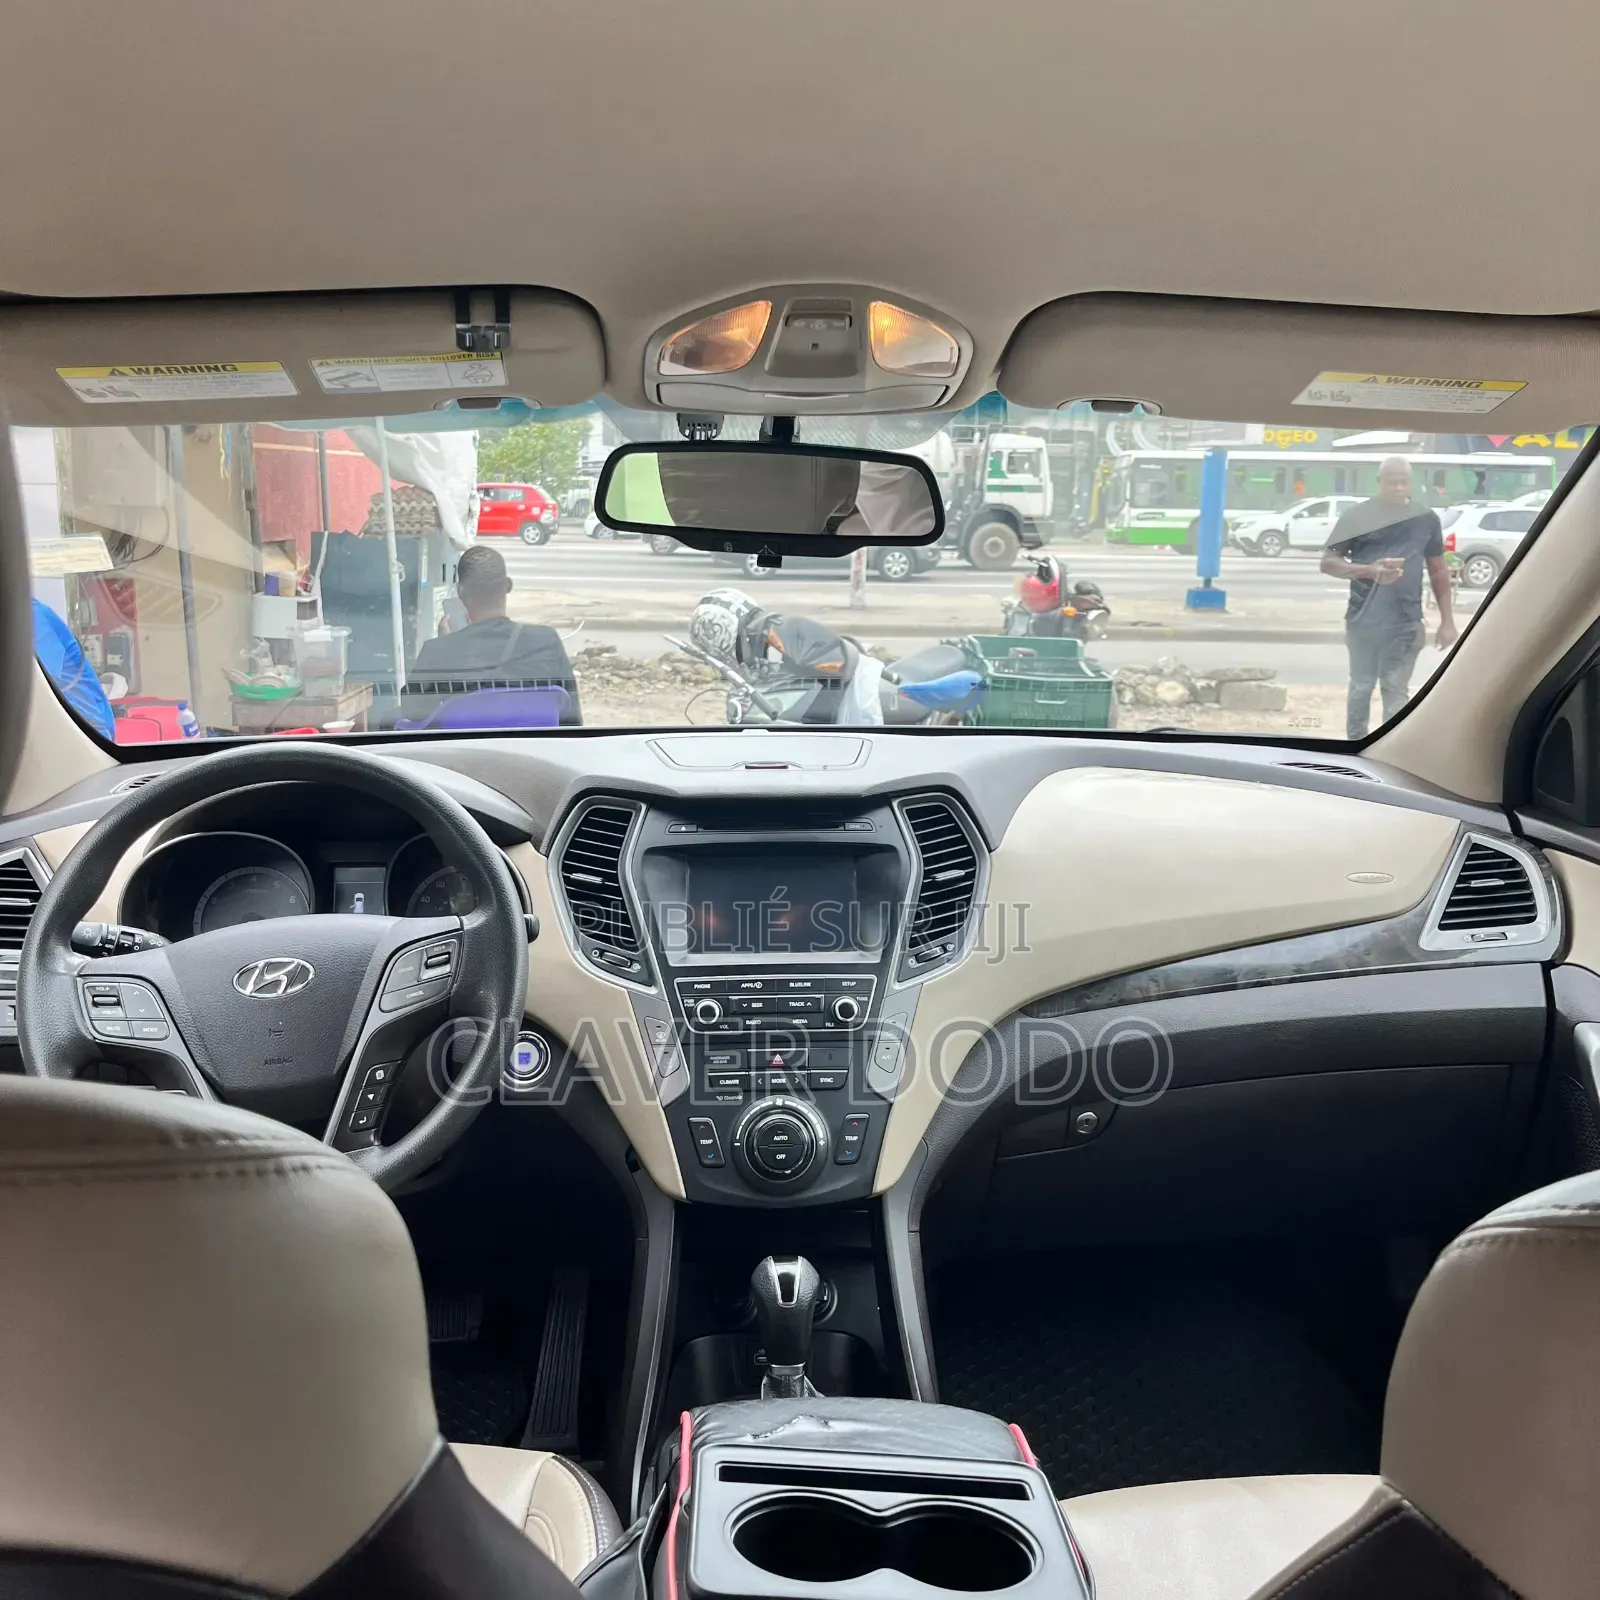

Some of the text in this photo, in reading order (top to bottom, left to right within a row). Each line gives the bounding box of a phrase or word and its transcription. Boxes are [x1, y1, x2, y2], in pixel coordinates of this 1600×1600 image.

[130, 363, 240, 377] WARNING
[1385, 376, 1484, 389] WARNING
[289, 895, 296, 904] 6
[406, 990, 425, 999] CANCEL
